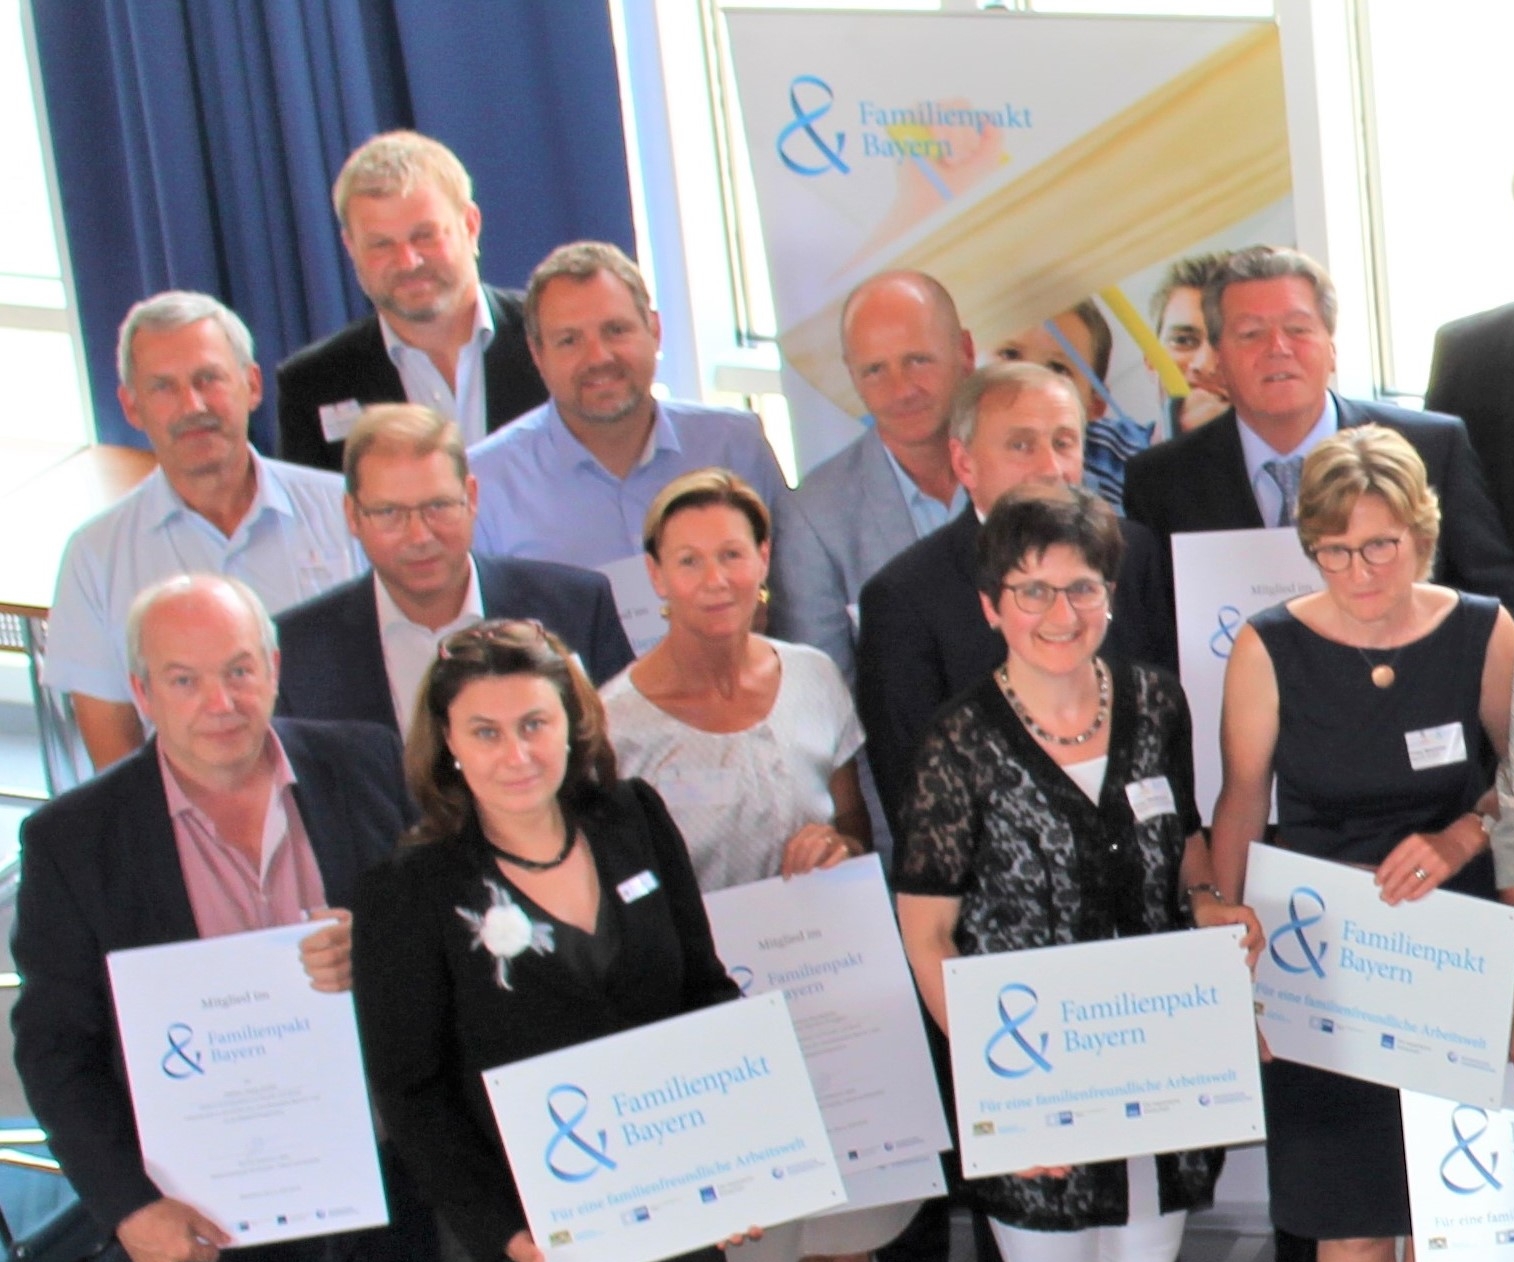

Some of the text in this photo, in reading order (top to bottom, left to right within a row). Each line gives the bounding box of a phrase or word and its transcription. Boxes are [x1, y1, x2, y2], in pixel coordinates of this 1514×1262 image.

[858, 100, 1033, 133] Familienpakt
[862, 132, 953, 161] Bayern
[758, 928, 823, 952] Mitglied im
[1342, 920, 1486, 975] Familienpakt
[767, 952, 864, 987] Familienpakt
[1339, 946, 1413, 985] Bayern
[201, 990, 270, 1010] Mitglied im
[784, 980, 825, 1000] ayern
[1061, 983, 1220, 1023] Familienpakt
[207, 1017, 311, 1045] Familienpakt
[1255, 982, 1275, 997] Für
[1277, 988, 1301, 1003] eine
[1304, 993, 1418, 1034] familienfreundliche
[1423, 1023, 1487, 1050] Arbeitswelt
[211, 1043, 266, 1066] Bayern
[1063, 1027, 1146, 1056] Bayern
[611, 1053, 772, 1118] Familienpakt
[979, 1099, 1002, 1113] Für
[1006, 1096, 1032, 1110] eine
[1035, 1079, 1162, 1106] familienfreundliche
[1166, 1069, 1237, 1090] Arbeitswelt
[619, 1108, 706, 1147] Bayern
[550, 1206, 574, 1223] Für
[577, 1199, 604, 1215] eine
[607, 1161, 732, 1205] familienfreundliche
[735, 1137, 806, 1168] Arbeitswelt
[1434, 1215, 1454, 1228] Für
[1459, 1214, 1483, 1226] eine
